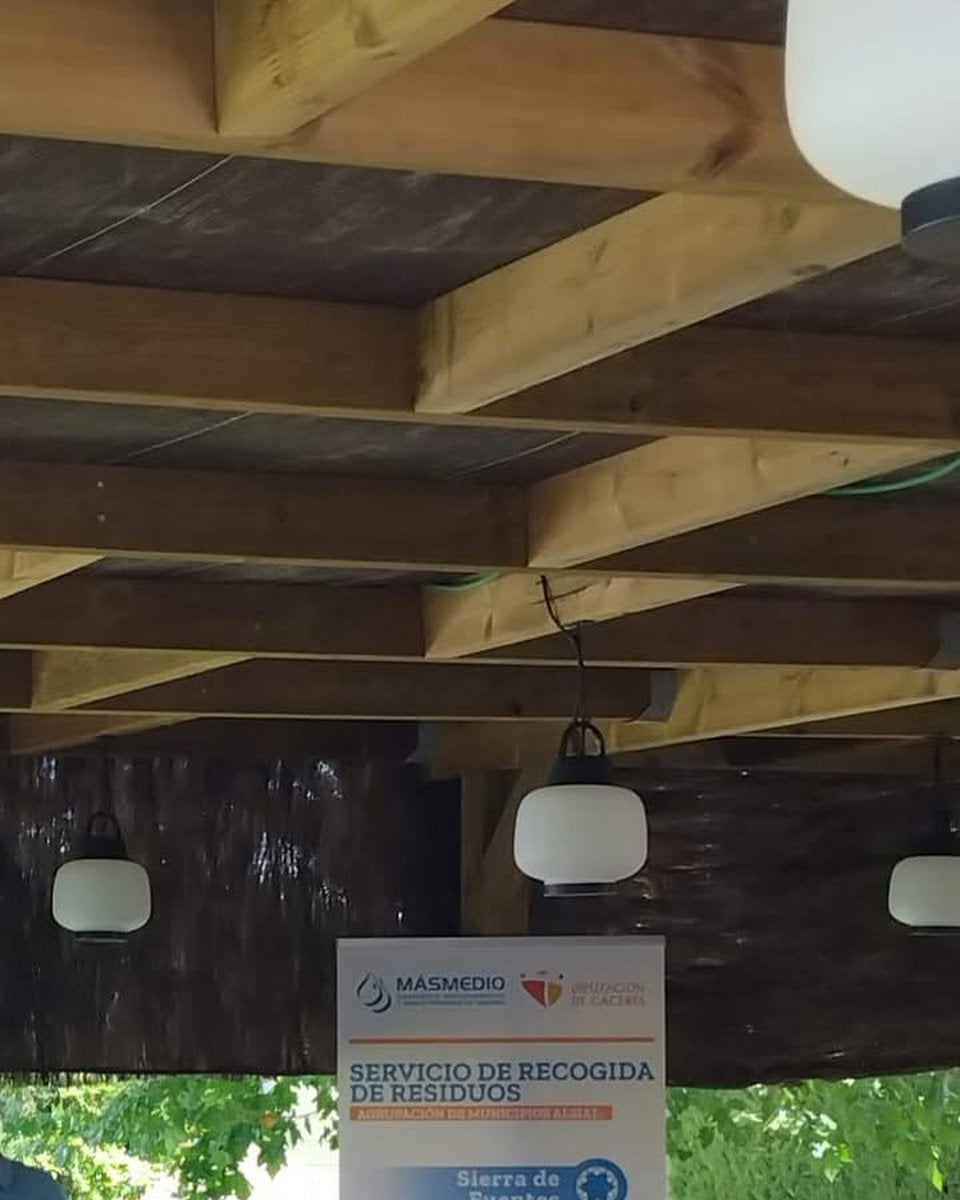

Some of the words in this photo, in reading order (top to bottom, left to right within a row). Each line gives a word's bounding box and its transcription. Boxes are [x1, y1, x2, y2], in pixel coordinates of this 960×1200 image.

[350, 1063, 472, 1083] SERVICIO
[479, 1063, 512, 1082] DE
[518, 1061, 655, 1081] RECOGIDA
[351, 1084, 384, 1103] DE
[392, 1083, 522, 1102] RESIDUOS
[456, 1170, 527, 1187] Sierra
[533, 1170, 560, 1187] de
